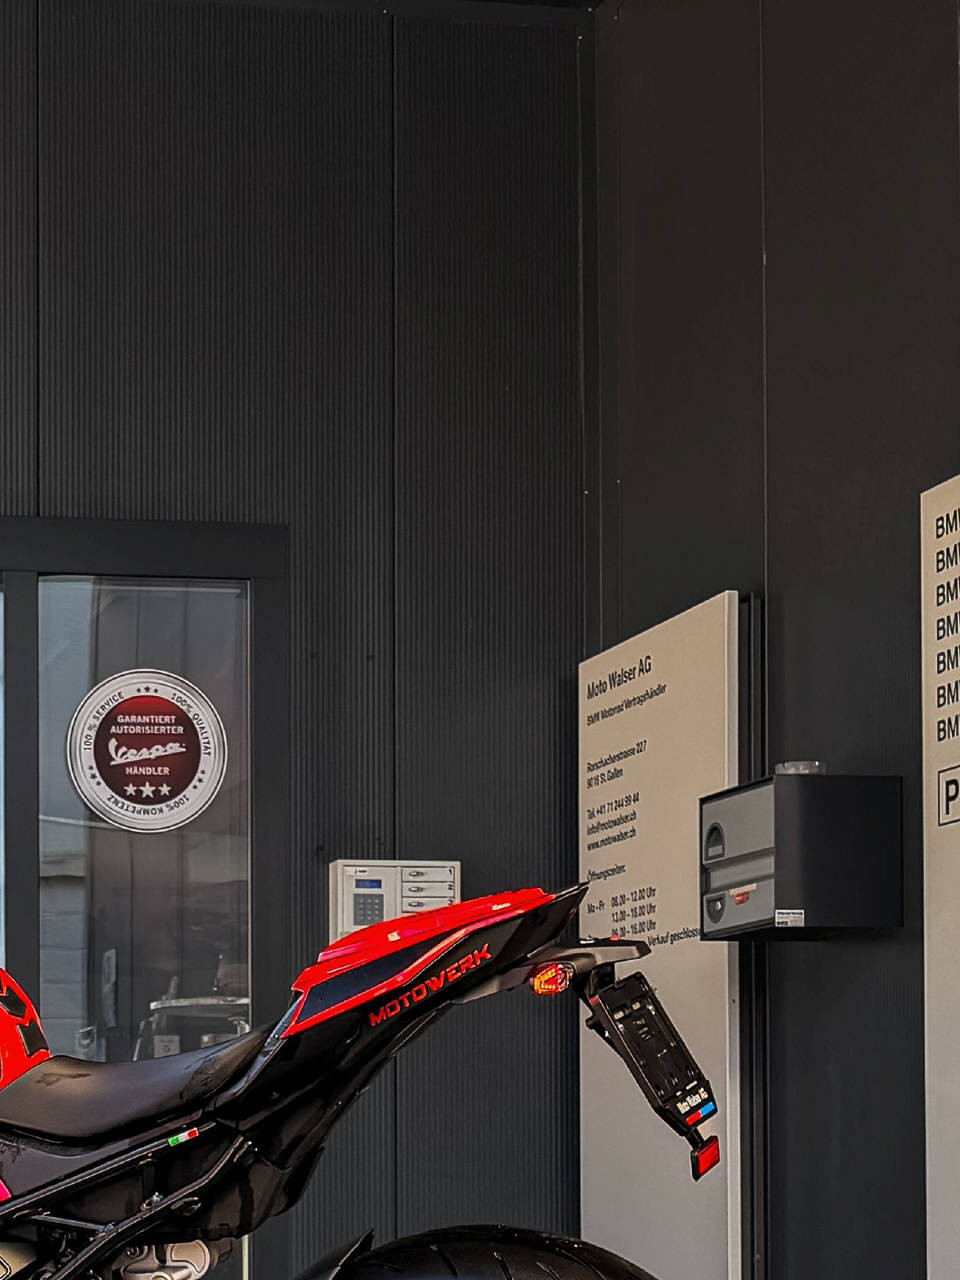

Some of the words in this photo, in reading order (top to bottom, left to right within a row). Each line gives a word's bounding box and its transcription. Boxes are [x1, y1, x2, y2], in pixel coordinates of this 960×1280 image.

[936, 508, 960, 539] BM
[936, 542, 960, 573] BM
[936, 576, 960, 607] BM
[937, 611, 960, 641] BM
[937, 645, 960, 674] BM
[587, 680, 607, 700] Moto
[608, 667, 636, 690] Walser
[638, 655, 651, 677] AG
[92, 691, 125, 722] SERVICE
[171, 693, 194, 713] 100%
[937, 680, 960, 708] BM
[110, 726, 184, 735] AUTORISIERTER
[117, 715, 176, 724] GARANTIERT
[937, 714, 960, 742] BM
[108, 737, 187, 766] Vespa
[125, 766, 170, 775] HÄNDLER
[107, 794, 164, 816] KOMPETENZ
[166, 794, 189, 812] 100%
[646, 886, 656, 898] Uhr
[646, 903, 656, 915] Uhr
[646, 919, 656, 932] Uhr
[369, 943, 491, 1027] MOTOWERK
